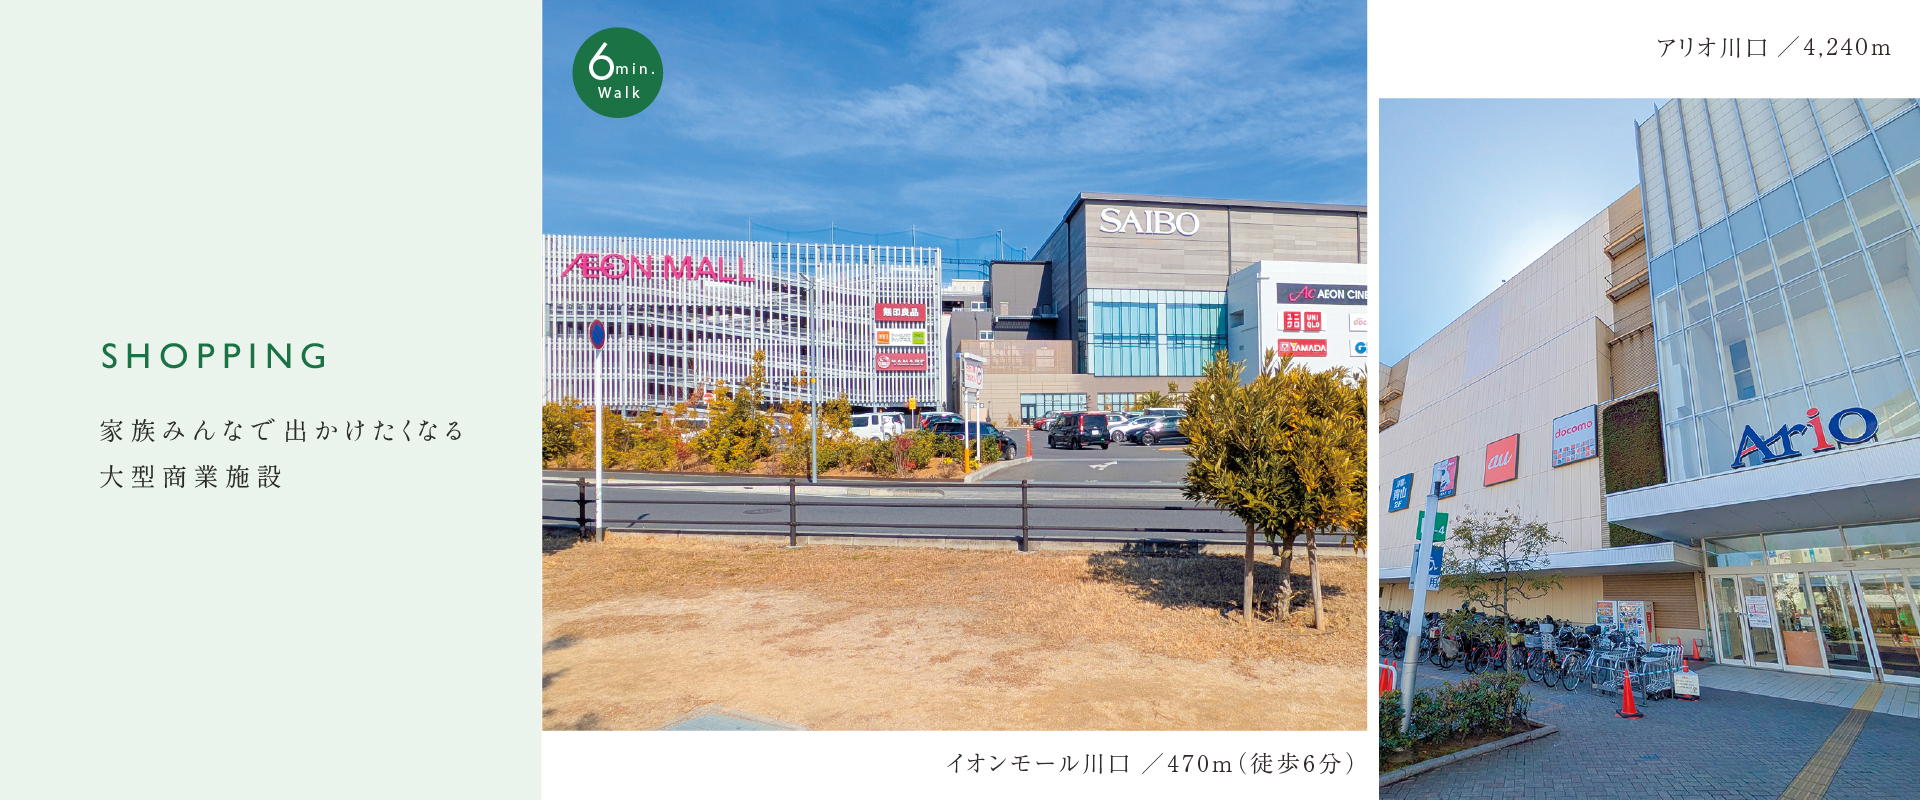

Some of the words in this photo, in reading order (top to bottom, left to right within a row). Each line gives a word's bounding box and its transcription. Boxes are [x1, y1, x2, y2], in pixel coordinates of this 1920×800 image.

[1099, 207, 1200, 236] SAIBO
[663, 254, 756, 283] MALL
[1317, 289, 1345, 299] AEON
[883, 307, 919, 317] 無印良品
[1306, 321, 1320, 329] QLO
[1290, 342, 1327, 352] YAMADA
[1554, 420, 1593, 439] docomo
[1731, 407, 1879, 469] Ario
[1487, 451, 1512, 470] au
[1394, 500, 1402, 509] 2F
